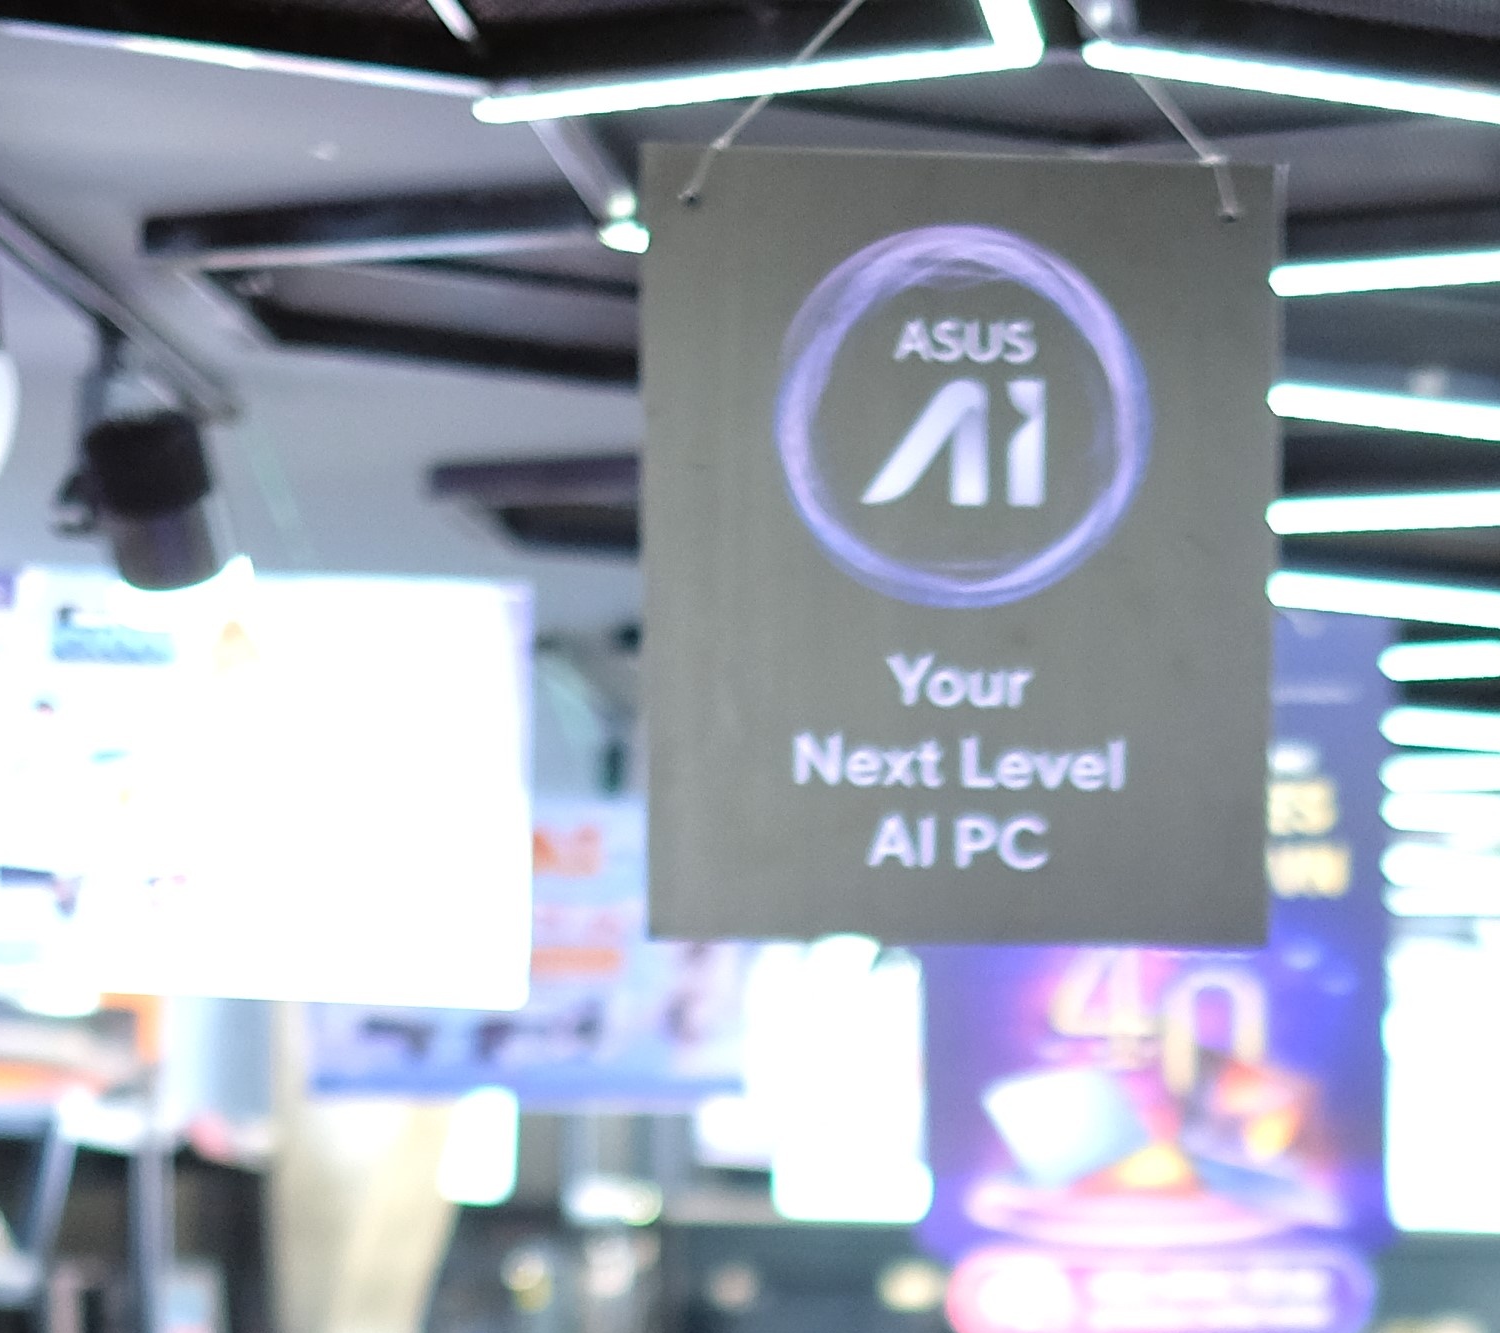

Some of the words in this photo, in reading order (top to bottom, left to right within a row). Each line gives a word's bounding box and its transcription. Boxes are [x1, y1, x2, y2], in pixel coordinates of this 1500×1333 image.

[894, 320, 1038, 365] ASUS
[886, 653, 1034, 710] Your
[793, 735, 945, 790] Next
[961, 738, 1128, 791] Level
[868, 819, 935, 869] AI
[956, 819, 1050, 871] PC
